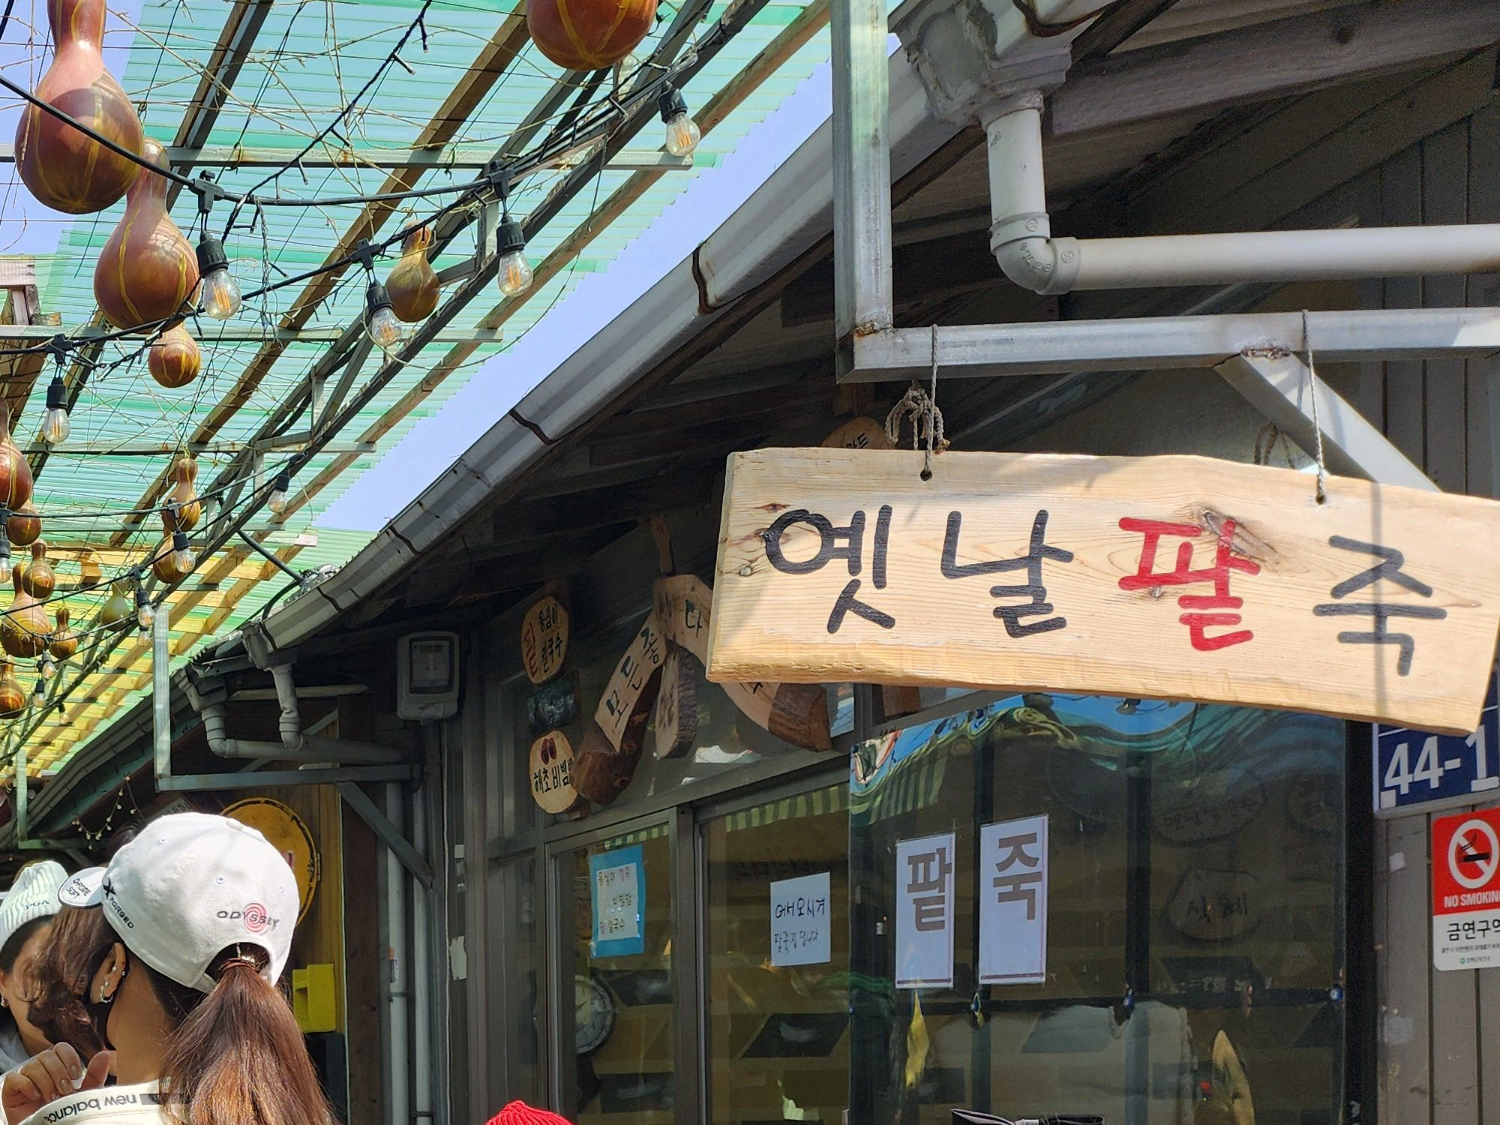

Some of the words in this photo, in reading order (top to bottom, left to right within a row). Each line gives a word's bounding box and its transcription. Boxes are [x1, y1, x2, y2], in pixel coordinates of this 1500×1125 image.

[764, 504, 1074, 639] 옛날
[1118, 516, 1449, 677] 팥죽
[907, 847, 952, 932] 팥
[993, 832, 1042, 921] 죽
[109, 896, 135, 930] FORGED
[1443, 895, 1459, 908] NO
[1460, 889, 1500, 907] SMOKIN
[216, 909, 278, 931] ODYSSEY
[104, 1093, 137, 1106] new
